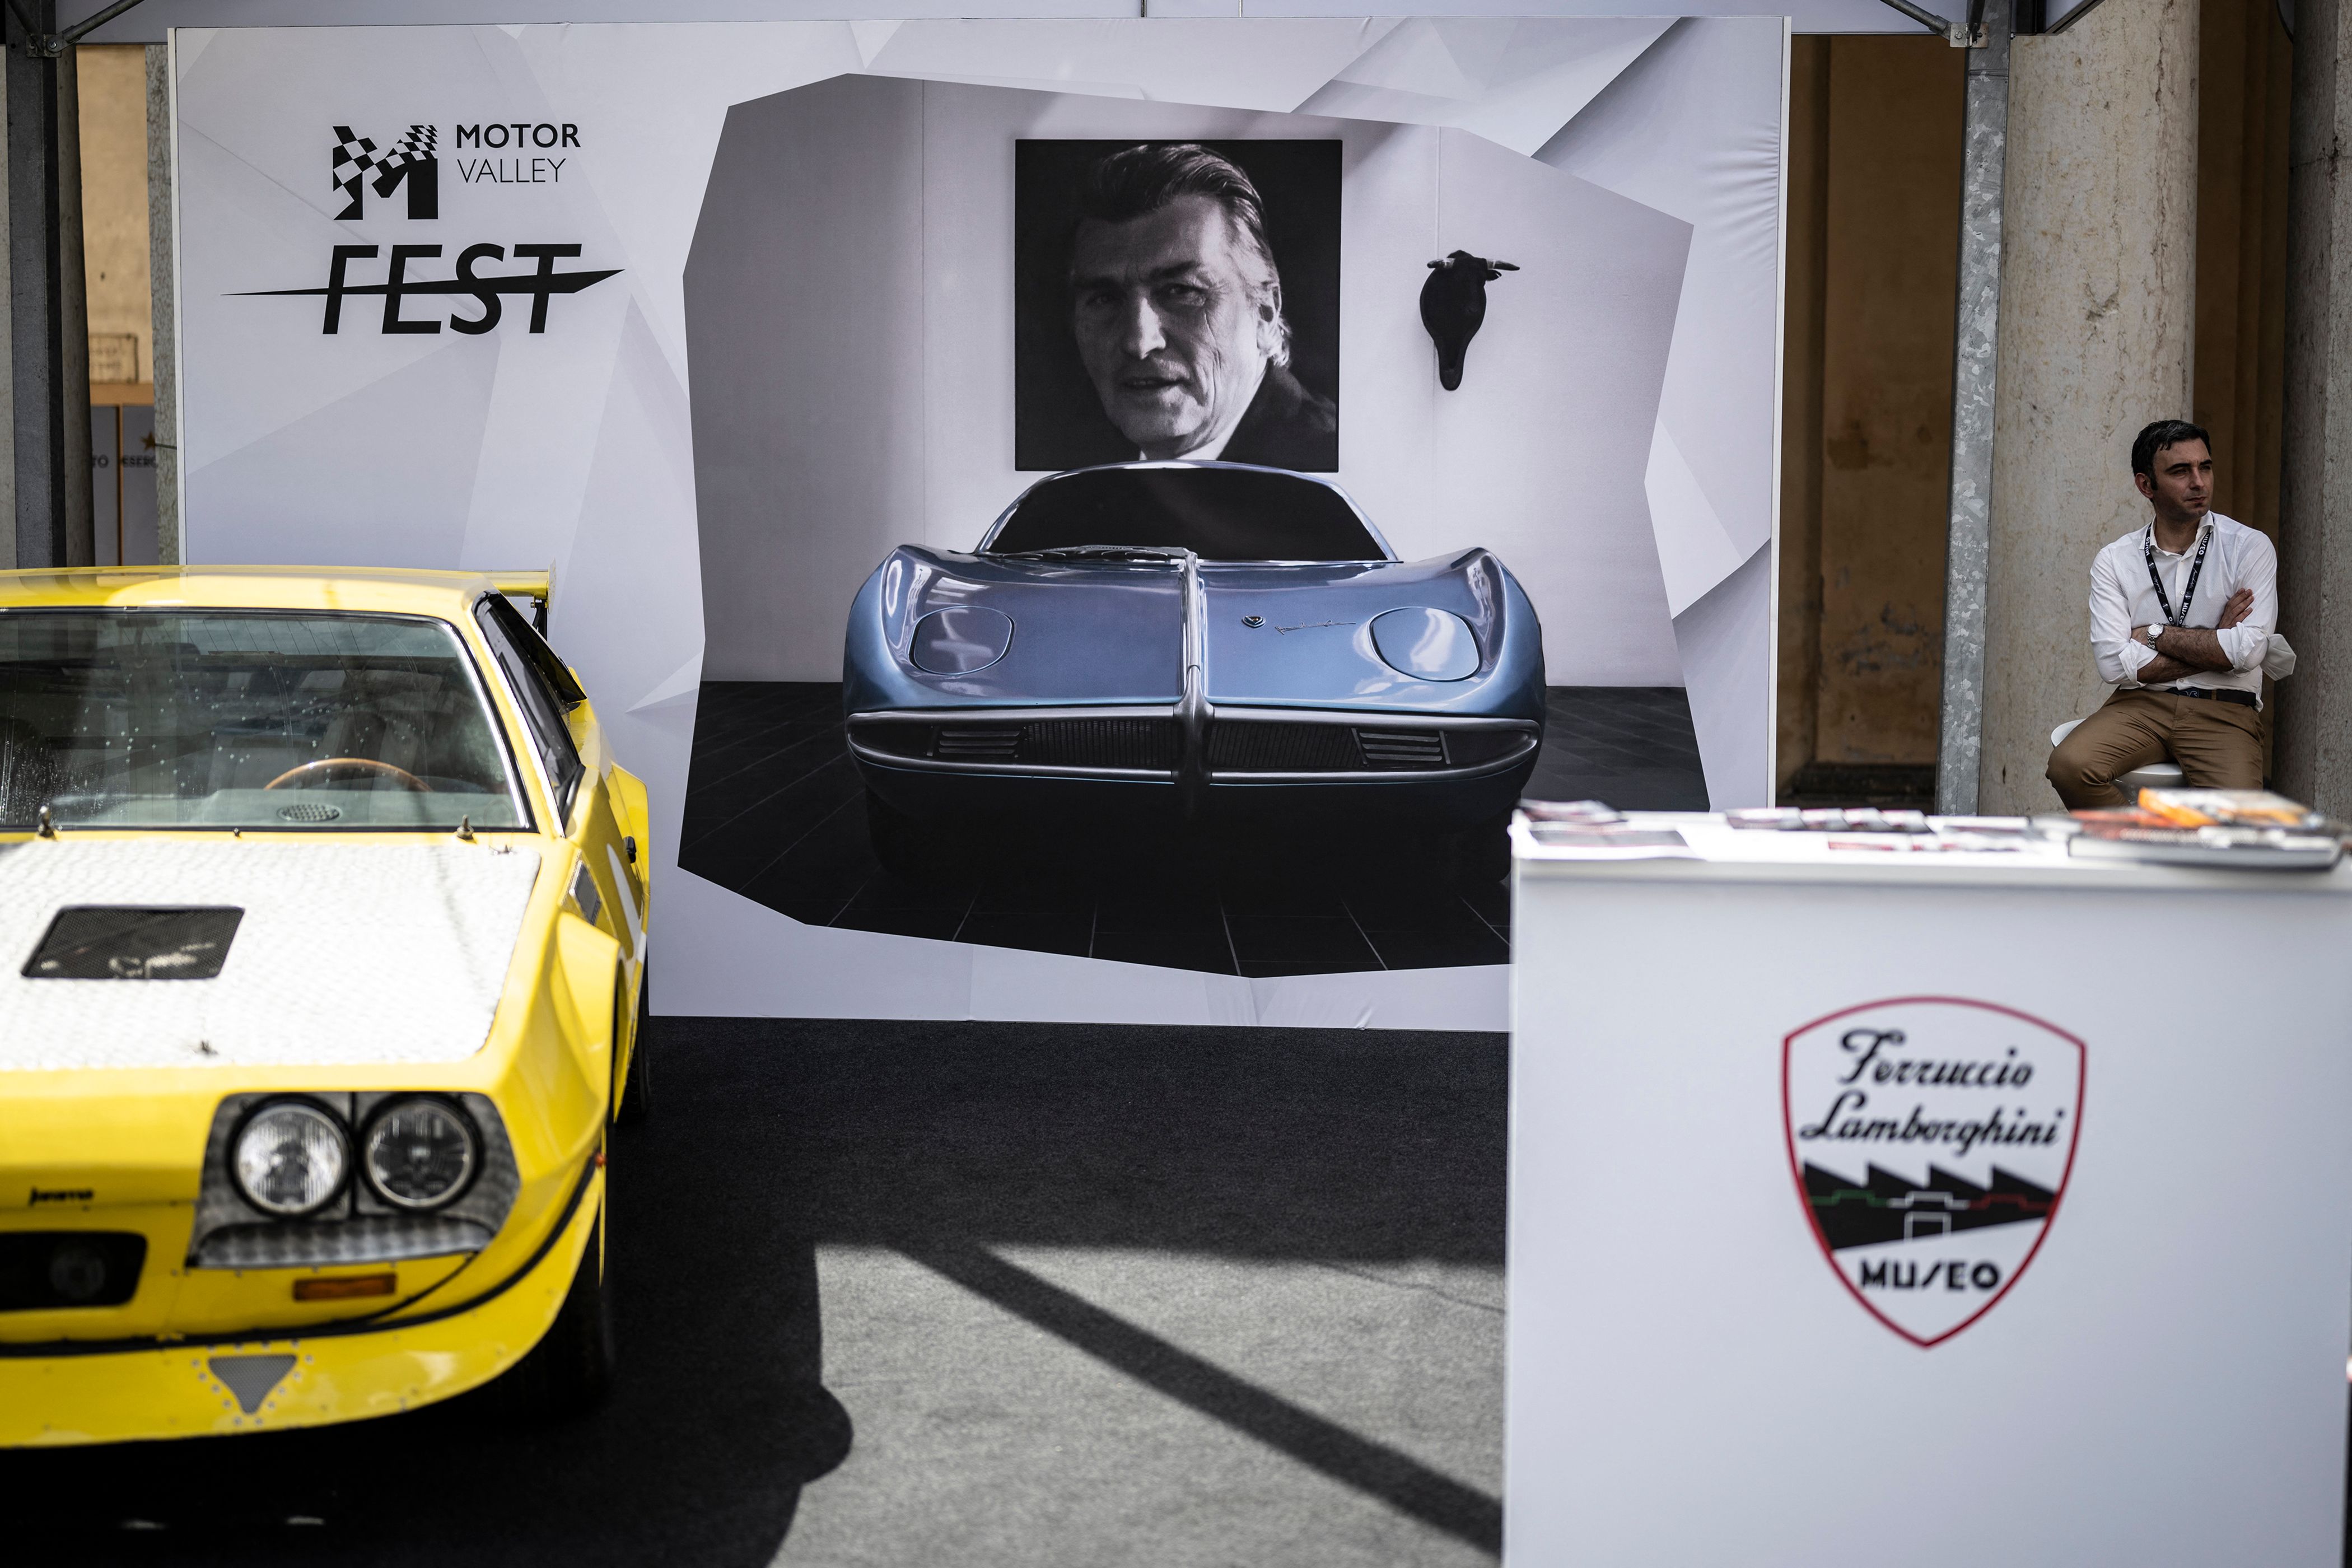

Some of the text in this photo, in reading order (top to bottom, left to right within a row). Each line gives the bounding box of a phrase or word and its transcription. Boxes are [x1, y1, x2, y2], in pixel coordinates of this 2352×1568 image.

[456, 123, 581, 148] MOTOR
[457, 158, 566, 183] VALLEY
[323, 242, 582, 335] FEST
[2179, 602, 2189, 624] MUSEO
[1840, 1028, 2034, 1088] Ferruccio
[1798, 1088, 2066, 1158] Lamborghini
[1859, 1259, 2000, 1291] MUSEO
